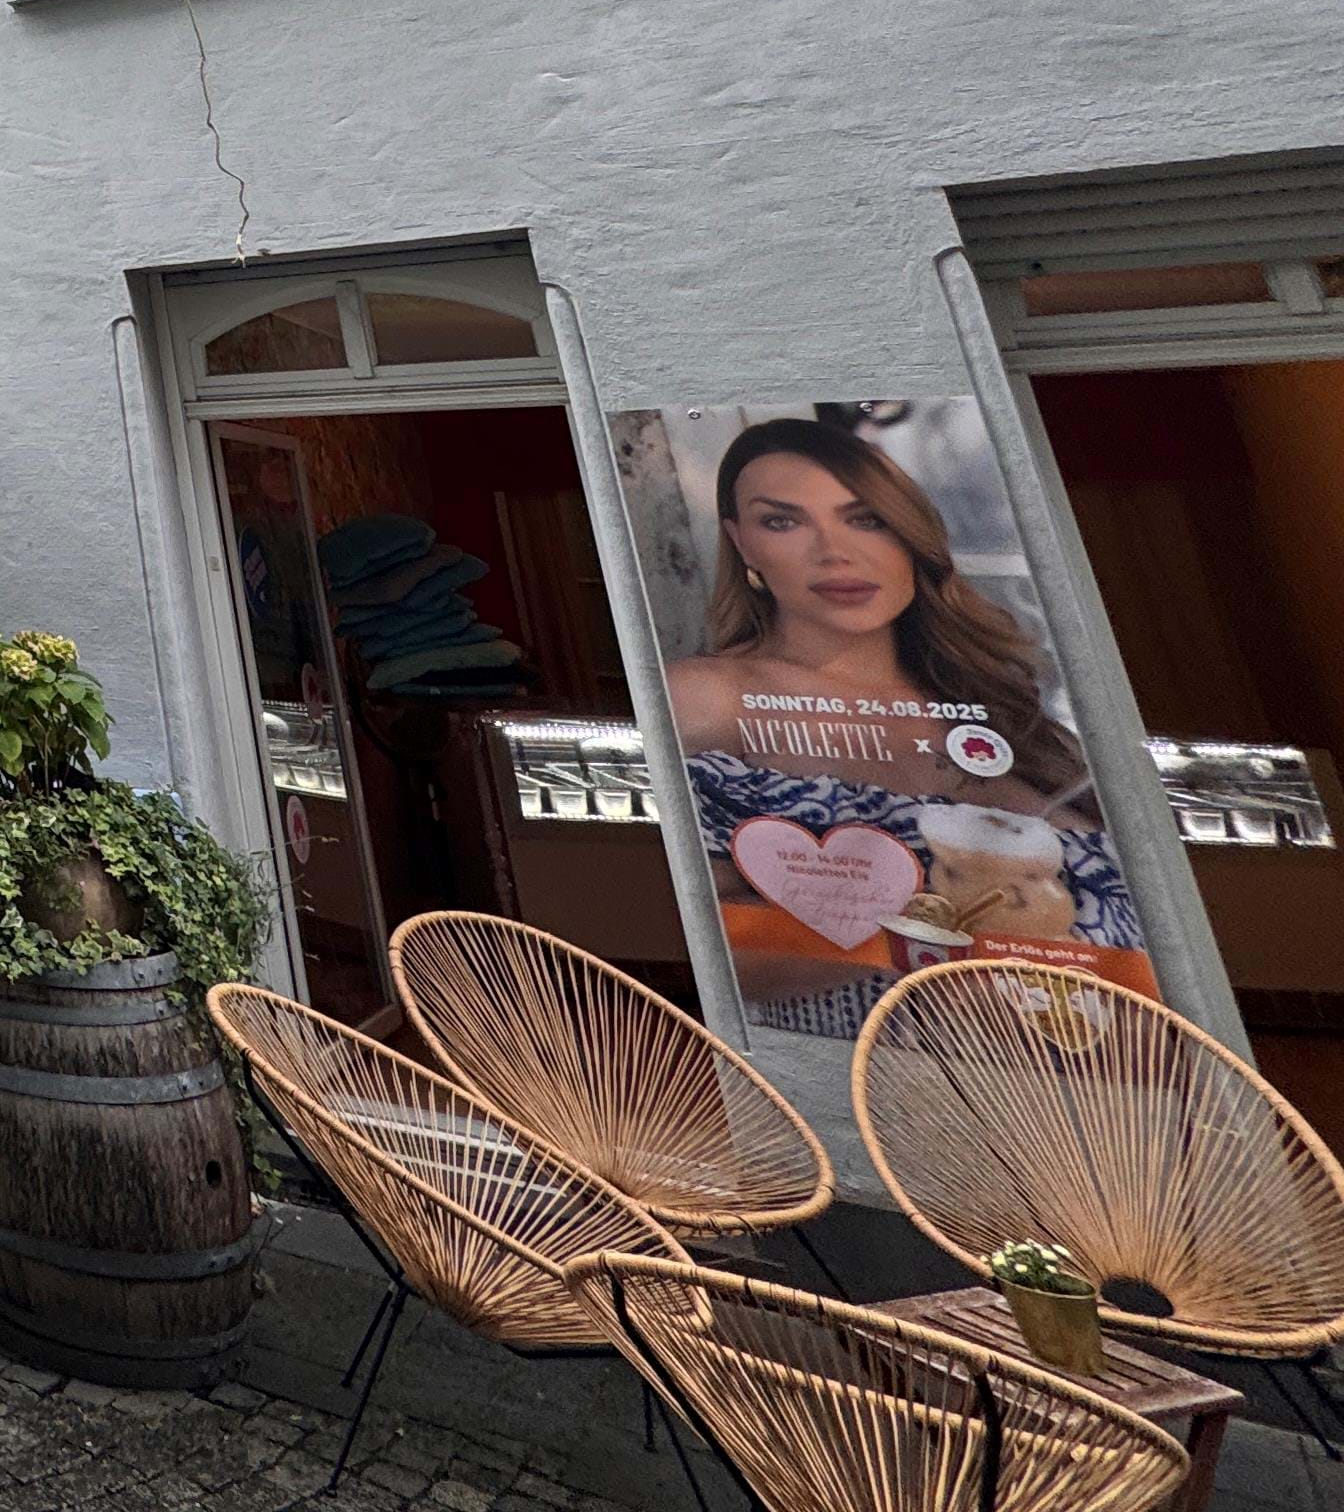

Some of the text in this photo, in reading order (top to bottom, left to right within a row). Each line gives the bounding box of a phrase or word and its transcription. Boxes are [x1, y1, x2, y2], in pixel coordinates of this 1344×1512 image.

[741, 693, 989, 721] SONNTAG, 24.08.2025
[736, 717, 894, 763] NICOLETTE
[984, 940, 1008, 953] Der
[1010, 942, 1044, 957] Erlös
[1045, 949, 1076, 962] geht
